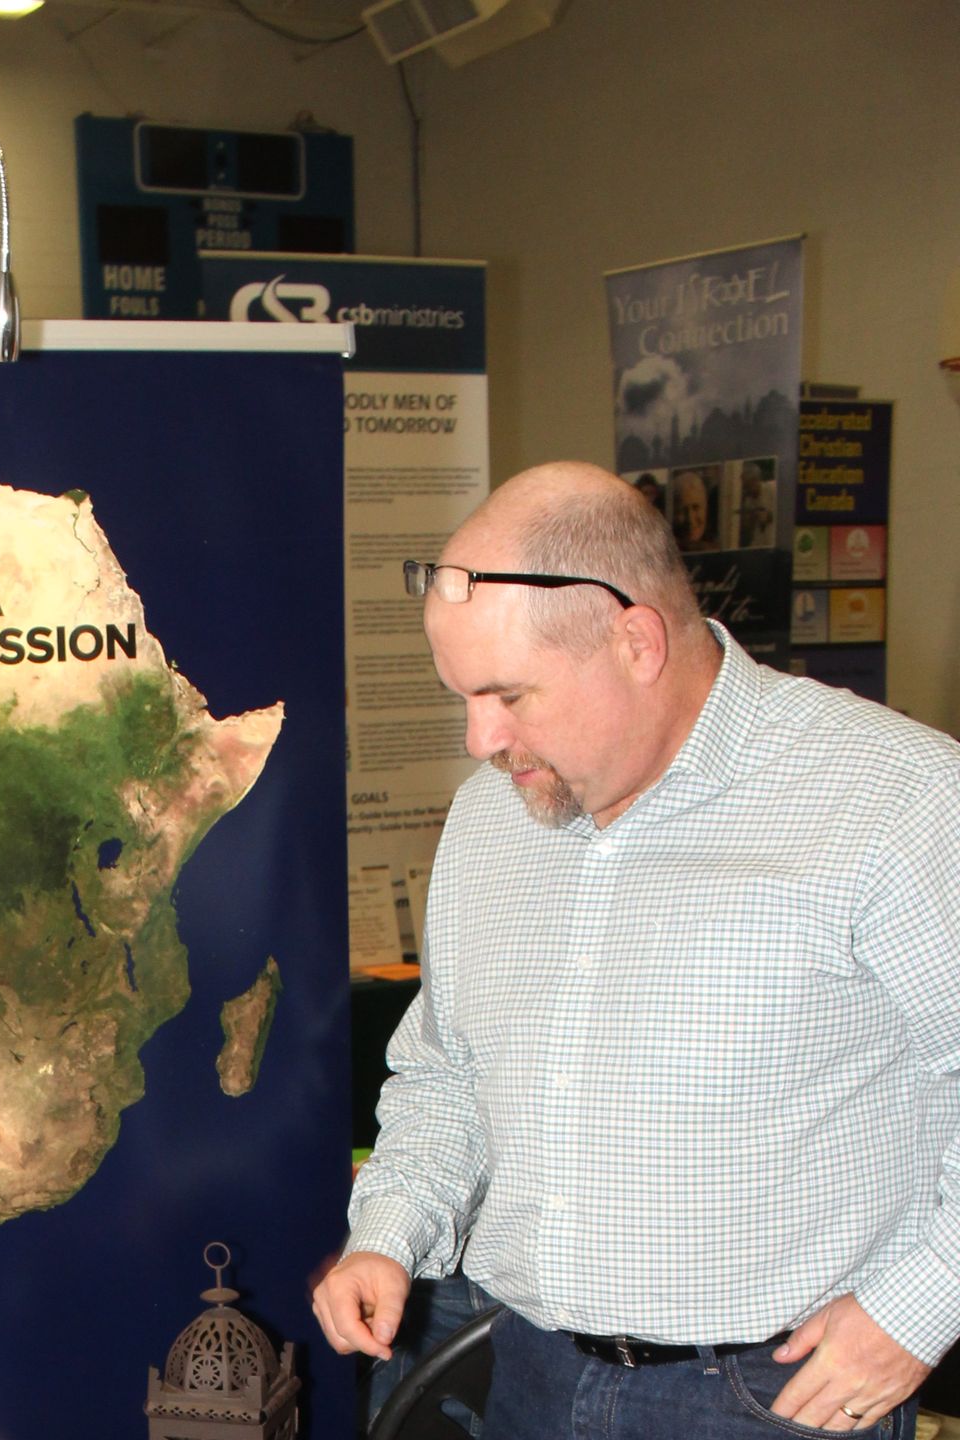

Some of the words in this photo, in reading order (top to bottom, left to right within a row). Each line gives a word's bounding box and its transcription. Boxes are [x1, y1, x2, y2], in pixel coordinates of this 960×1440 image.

[196, 228, 252, 249] PERIOD
[103, 265, 166, 291] HOME
[110, 296, 160, 316] FOULS
[337, 303, 464, 328] csbministries
[615, 293, 667, 325] Your
[641, 311, 788, 356] Connection
[344, 393, 388, 411] ODLY
[394, 394, 430, 410] MEN
[435, 394, 457, 411] OF
[356, 417, 457, 434] TOMORROW
[799, 408, 872, 430] ccelerated
[807, 488, 855, 511] Canada
[352, 791, 389, 805] GOALS
